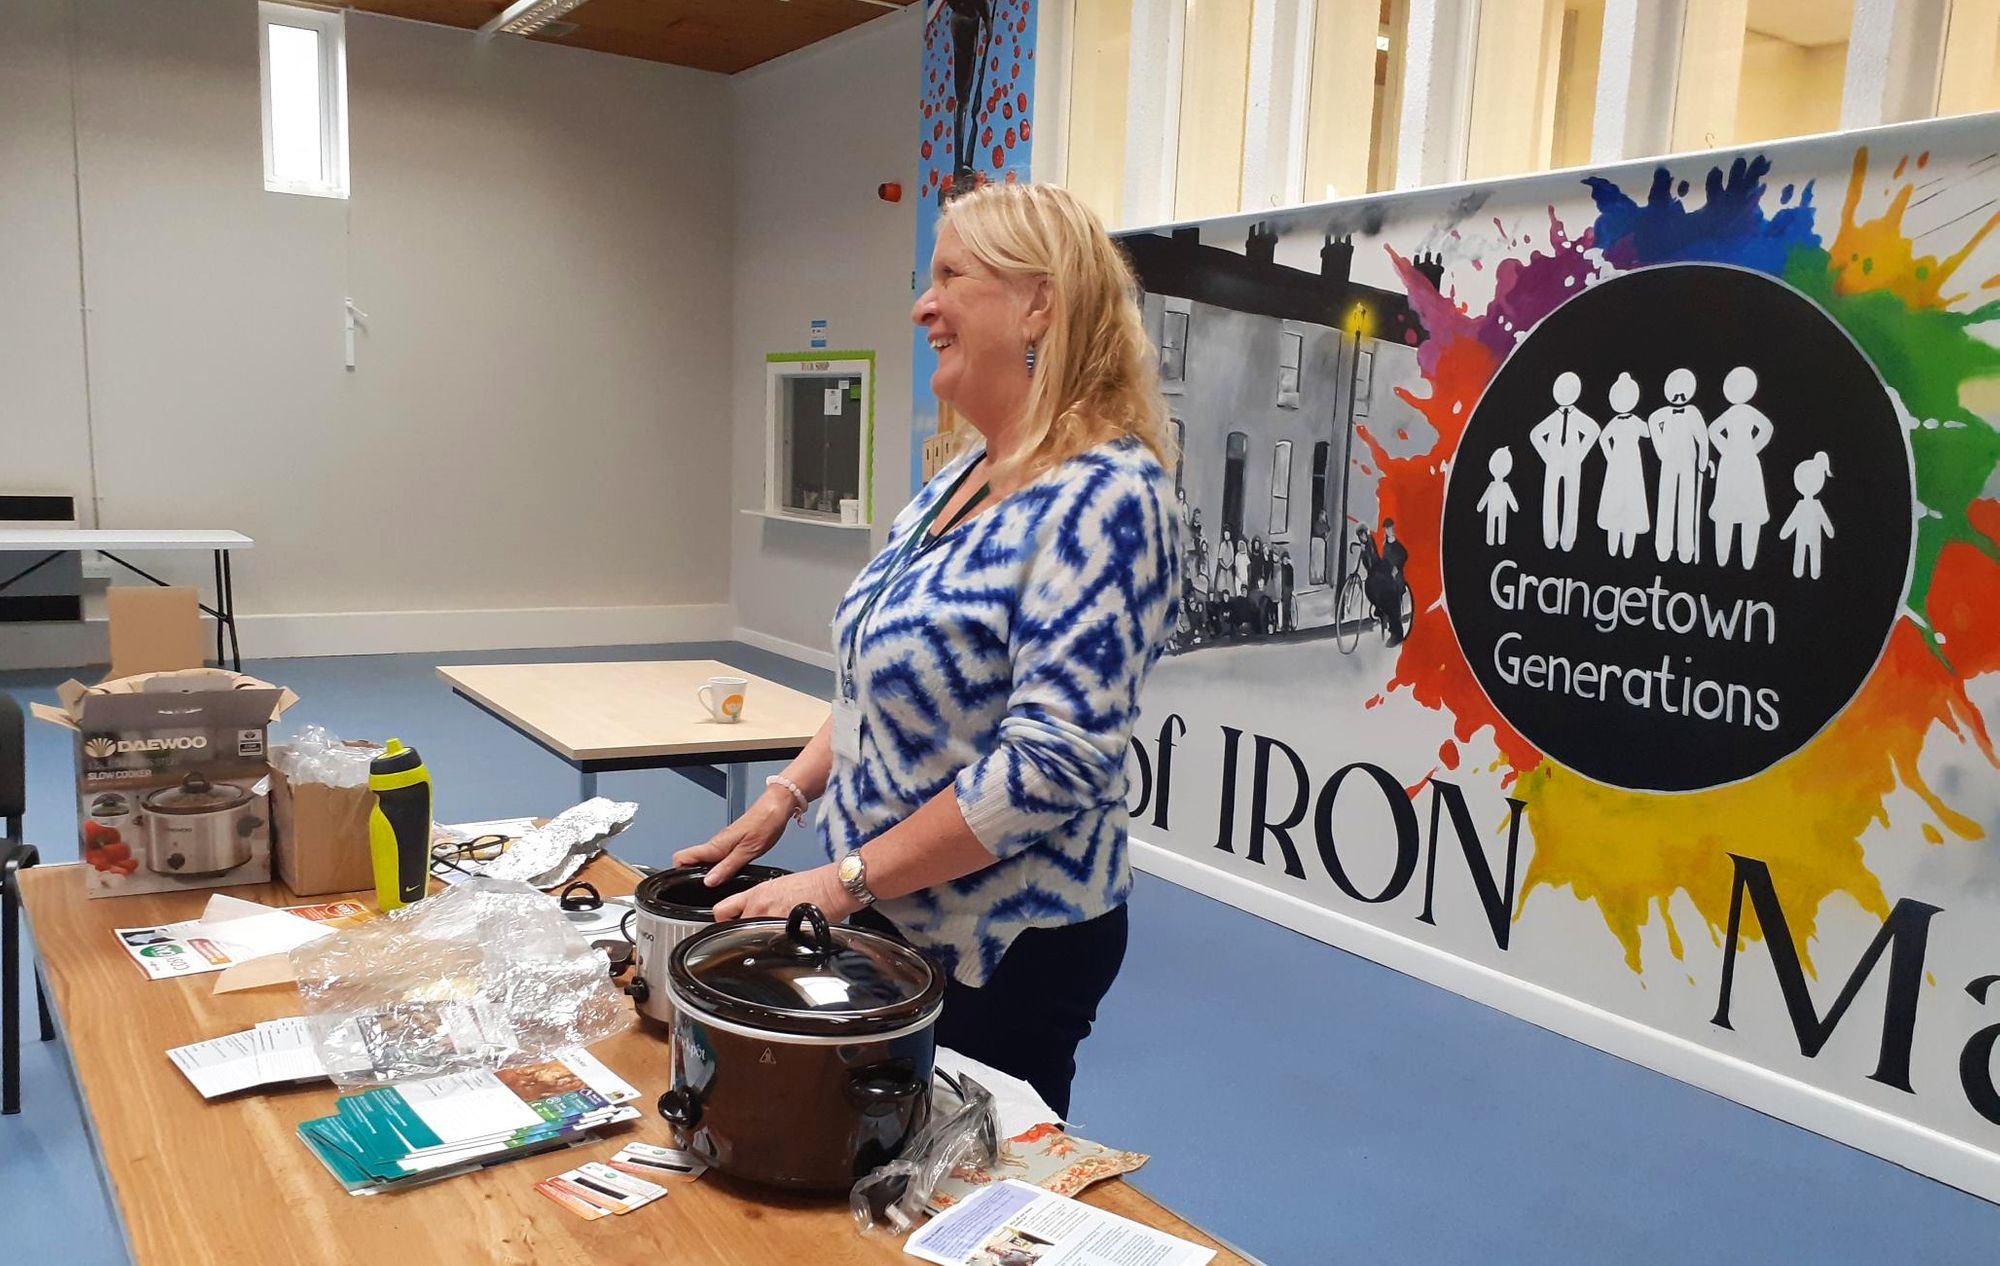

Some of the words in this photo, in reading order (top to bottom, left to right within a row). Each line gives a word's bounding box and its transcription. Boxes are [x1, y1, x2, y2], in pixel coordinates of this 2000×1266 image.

[1490, 559, 1776, 645] Grangetown
[1493, 632, 1780, 731] Generations
[87, 771, 115, 781] SLOW
[115, 769, 152, 780] COOKER
[117, 735, 208, 753] DAEWOO
[1214, 726, 1527, 950] IRON
